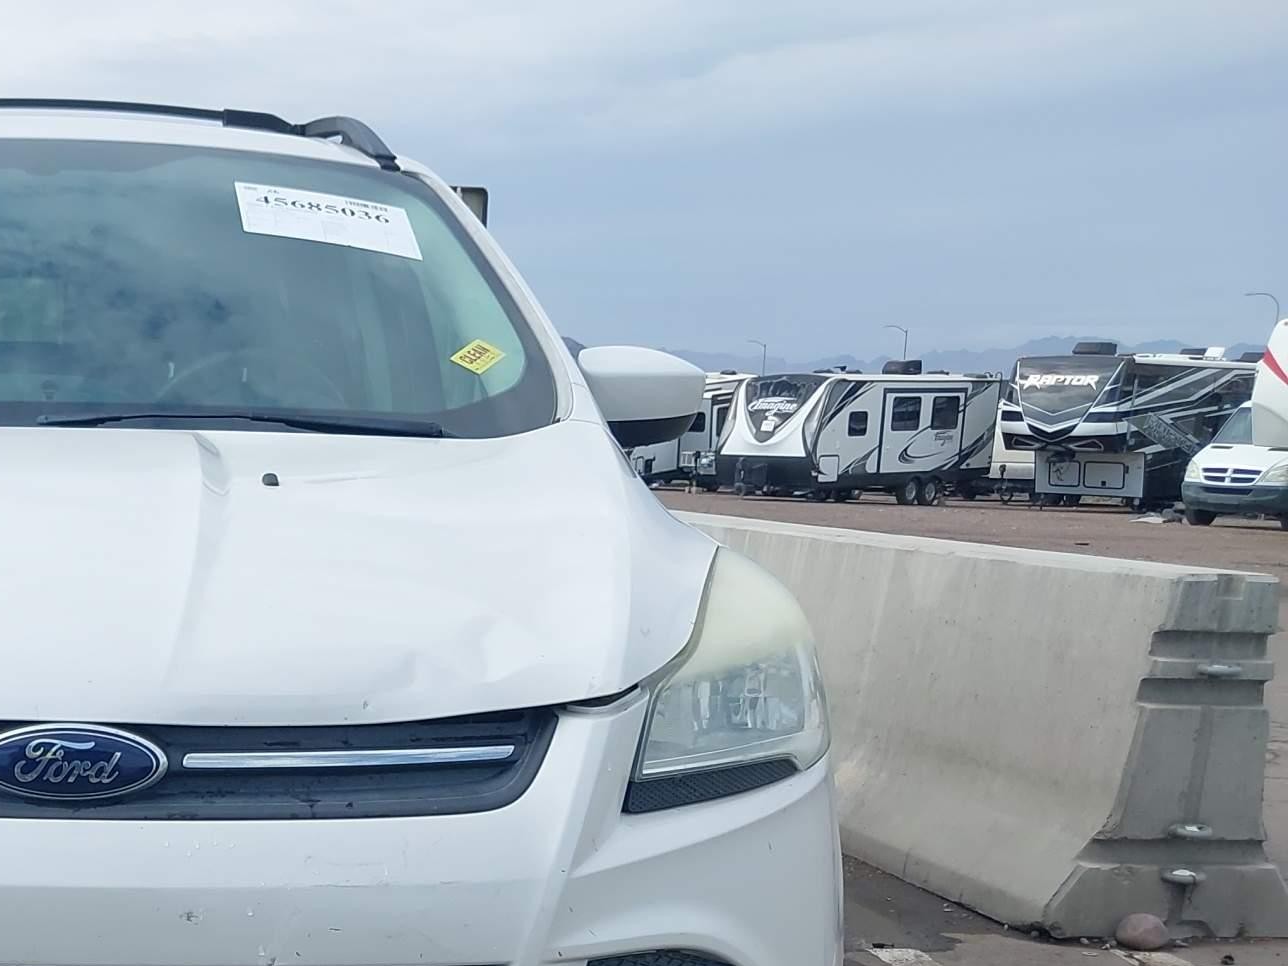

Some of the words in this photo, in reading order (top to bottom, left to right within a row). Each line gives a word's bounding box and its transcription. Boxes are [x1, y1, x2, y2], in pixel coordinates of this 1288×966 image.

[256, 195, 390, 224] 45685036
[1020, 374, 1099, 390] RAPTOR
[748, 397, 798, 416] Imagine
[14, 738, 122, 784] Ford
